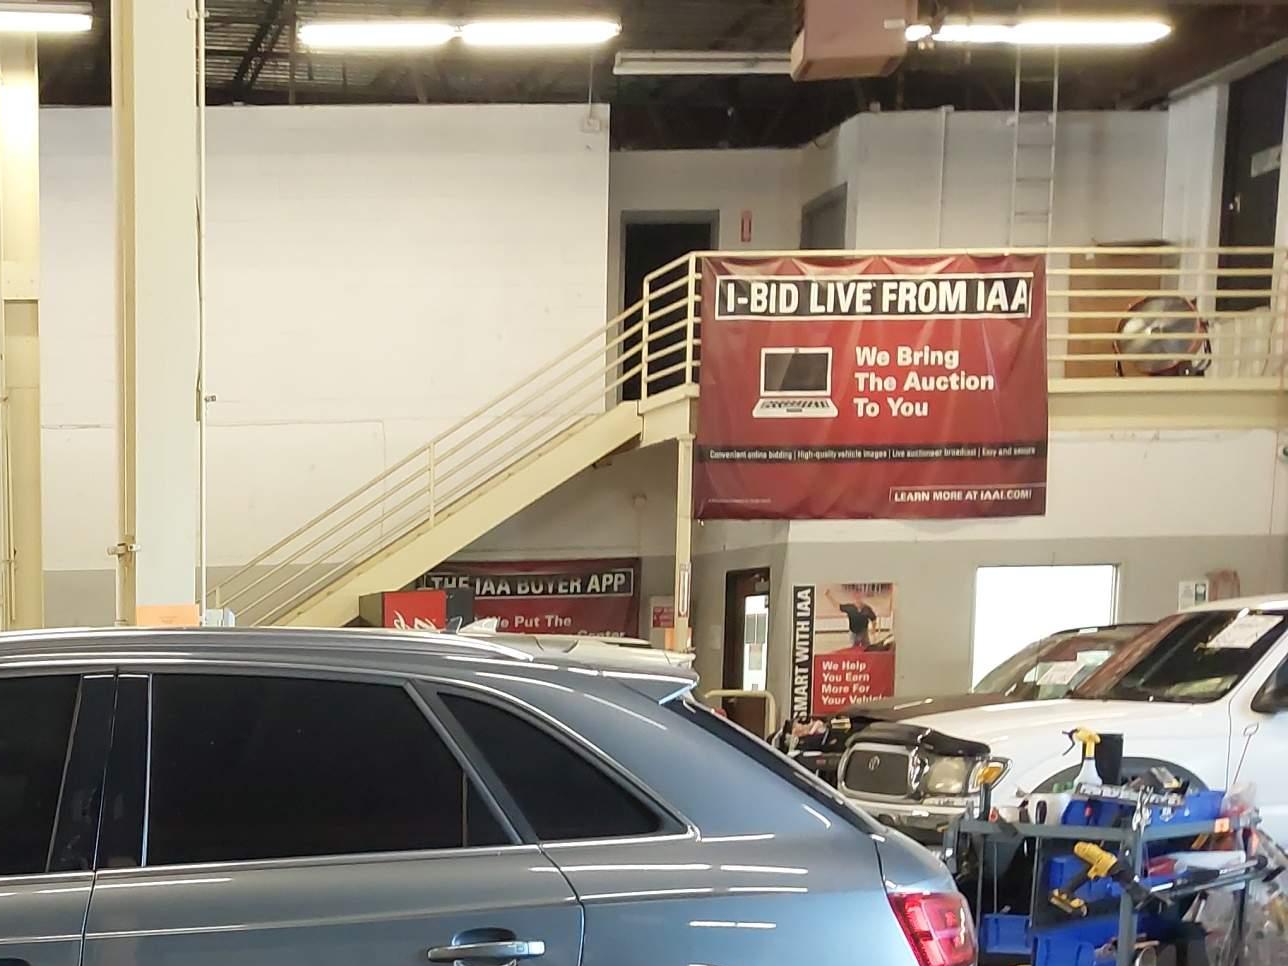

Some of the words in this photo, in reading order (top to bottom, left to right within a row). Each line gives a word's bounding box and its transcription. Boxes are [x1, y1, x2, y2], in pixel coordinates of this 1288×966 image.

[726, 282, 799, 314] I-BID
[809, 281, 873, 313] LIVE
[882, 280, 967, 313] FROM
[976, 279, 1028, 312] IAA
[855, 346, 890, 367] We
[896, 345, 960, 370] Bring
[854, 371, 897, 392] The
[903, 370, 994, 391] Auction
[853, 397, 880, 417] To
[887, 396, 929, 417] You
[894, 491, 930, 502] LEARN
[932, 490, 963, 501] MORE
[965, 490, 978, 501] AT
[475, 577, 508, 595] IAA
[587, 573, 626, 593] APP
[796, 588, 811, 617] IAA
[514, 615, 539, 628] Put
[545, 615, 572, 628] The
[795, 619, 810, 663] WITH
[822, 660, 839, 670] We
[842, 660, 867, 672] Help
[822, 672, 842, 682] You
[845, 672, 870, 682] Earn
[821, 683, 850, 693] More
[852, 683, 871, 693] For
[822, 695, 846, 705] Your
